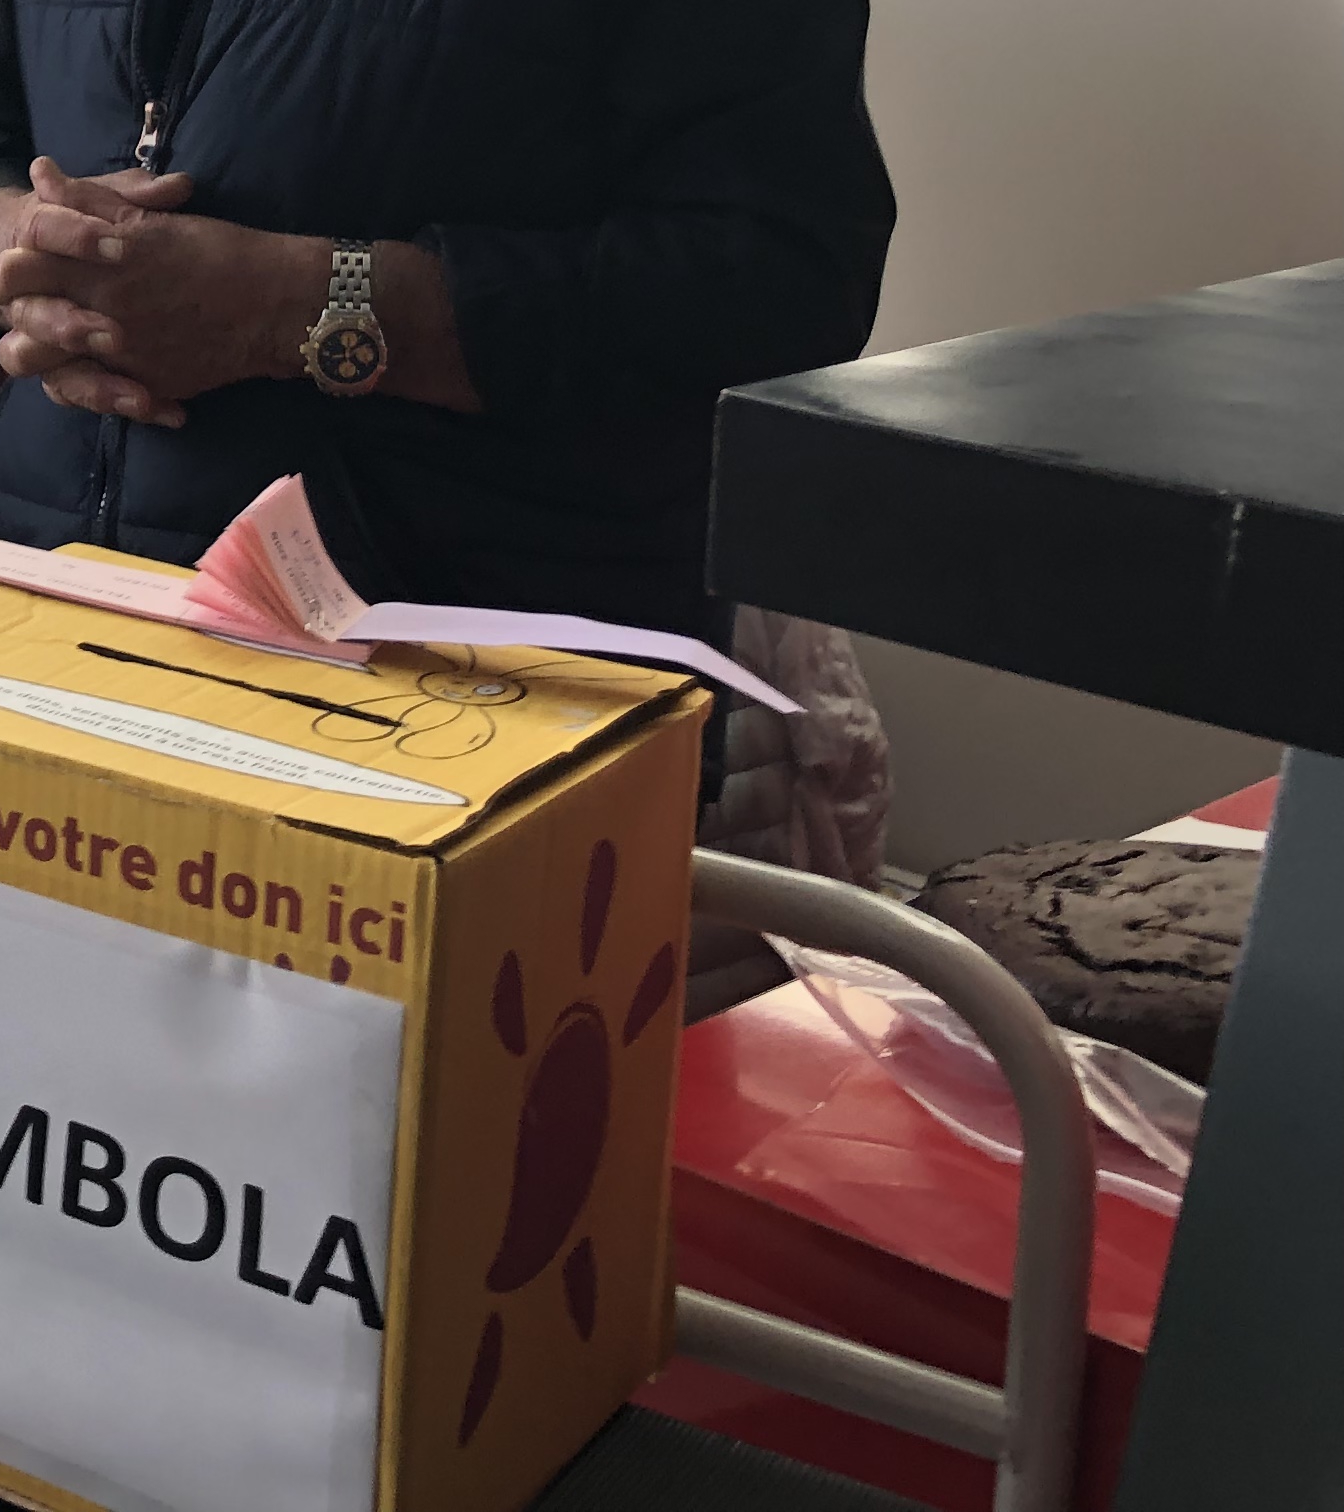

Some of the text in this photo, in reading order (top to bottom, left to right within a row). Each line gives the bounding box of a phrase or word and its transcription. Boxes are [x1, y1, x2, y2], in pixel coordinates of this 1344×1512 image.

[185, 735, 233, 752] sans
[236, 749, 310, 772] aucune
[178, 849, 304, 936] don
[324, 881, 407, 965] ici
